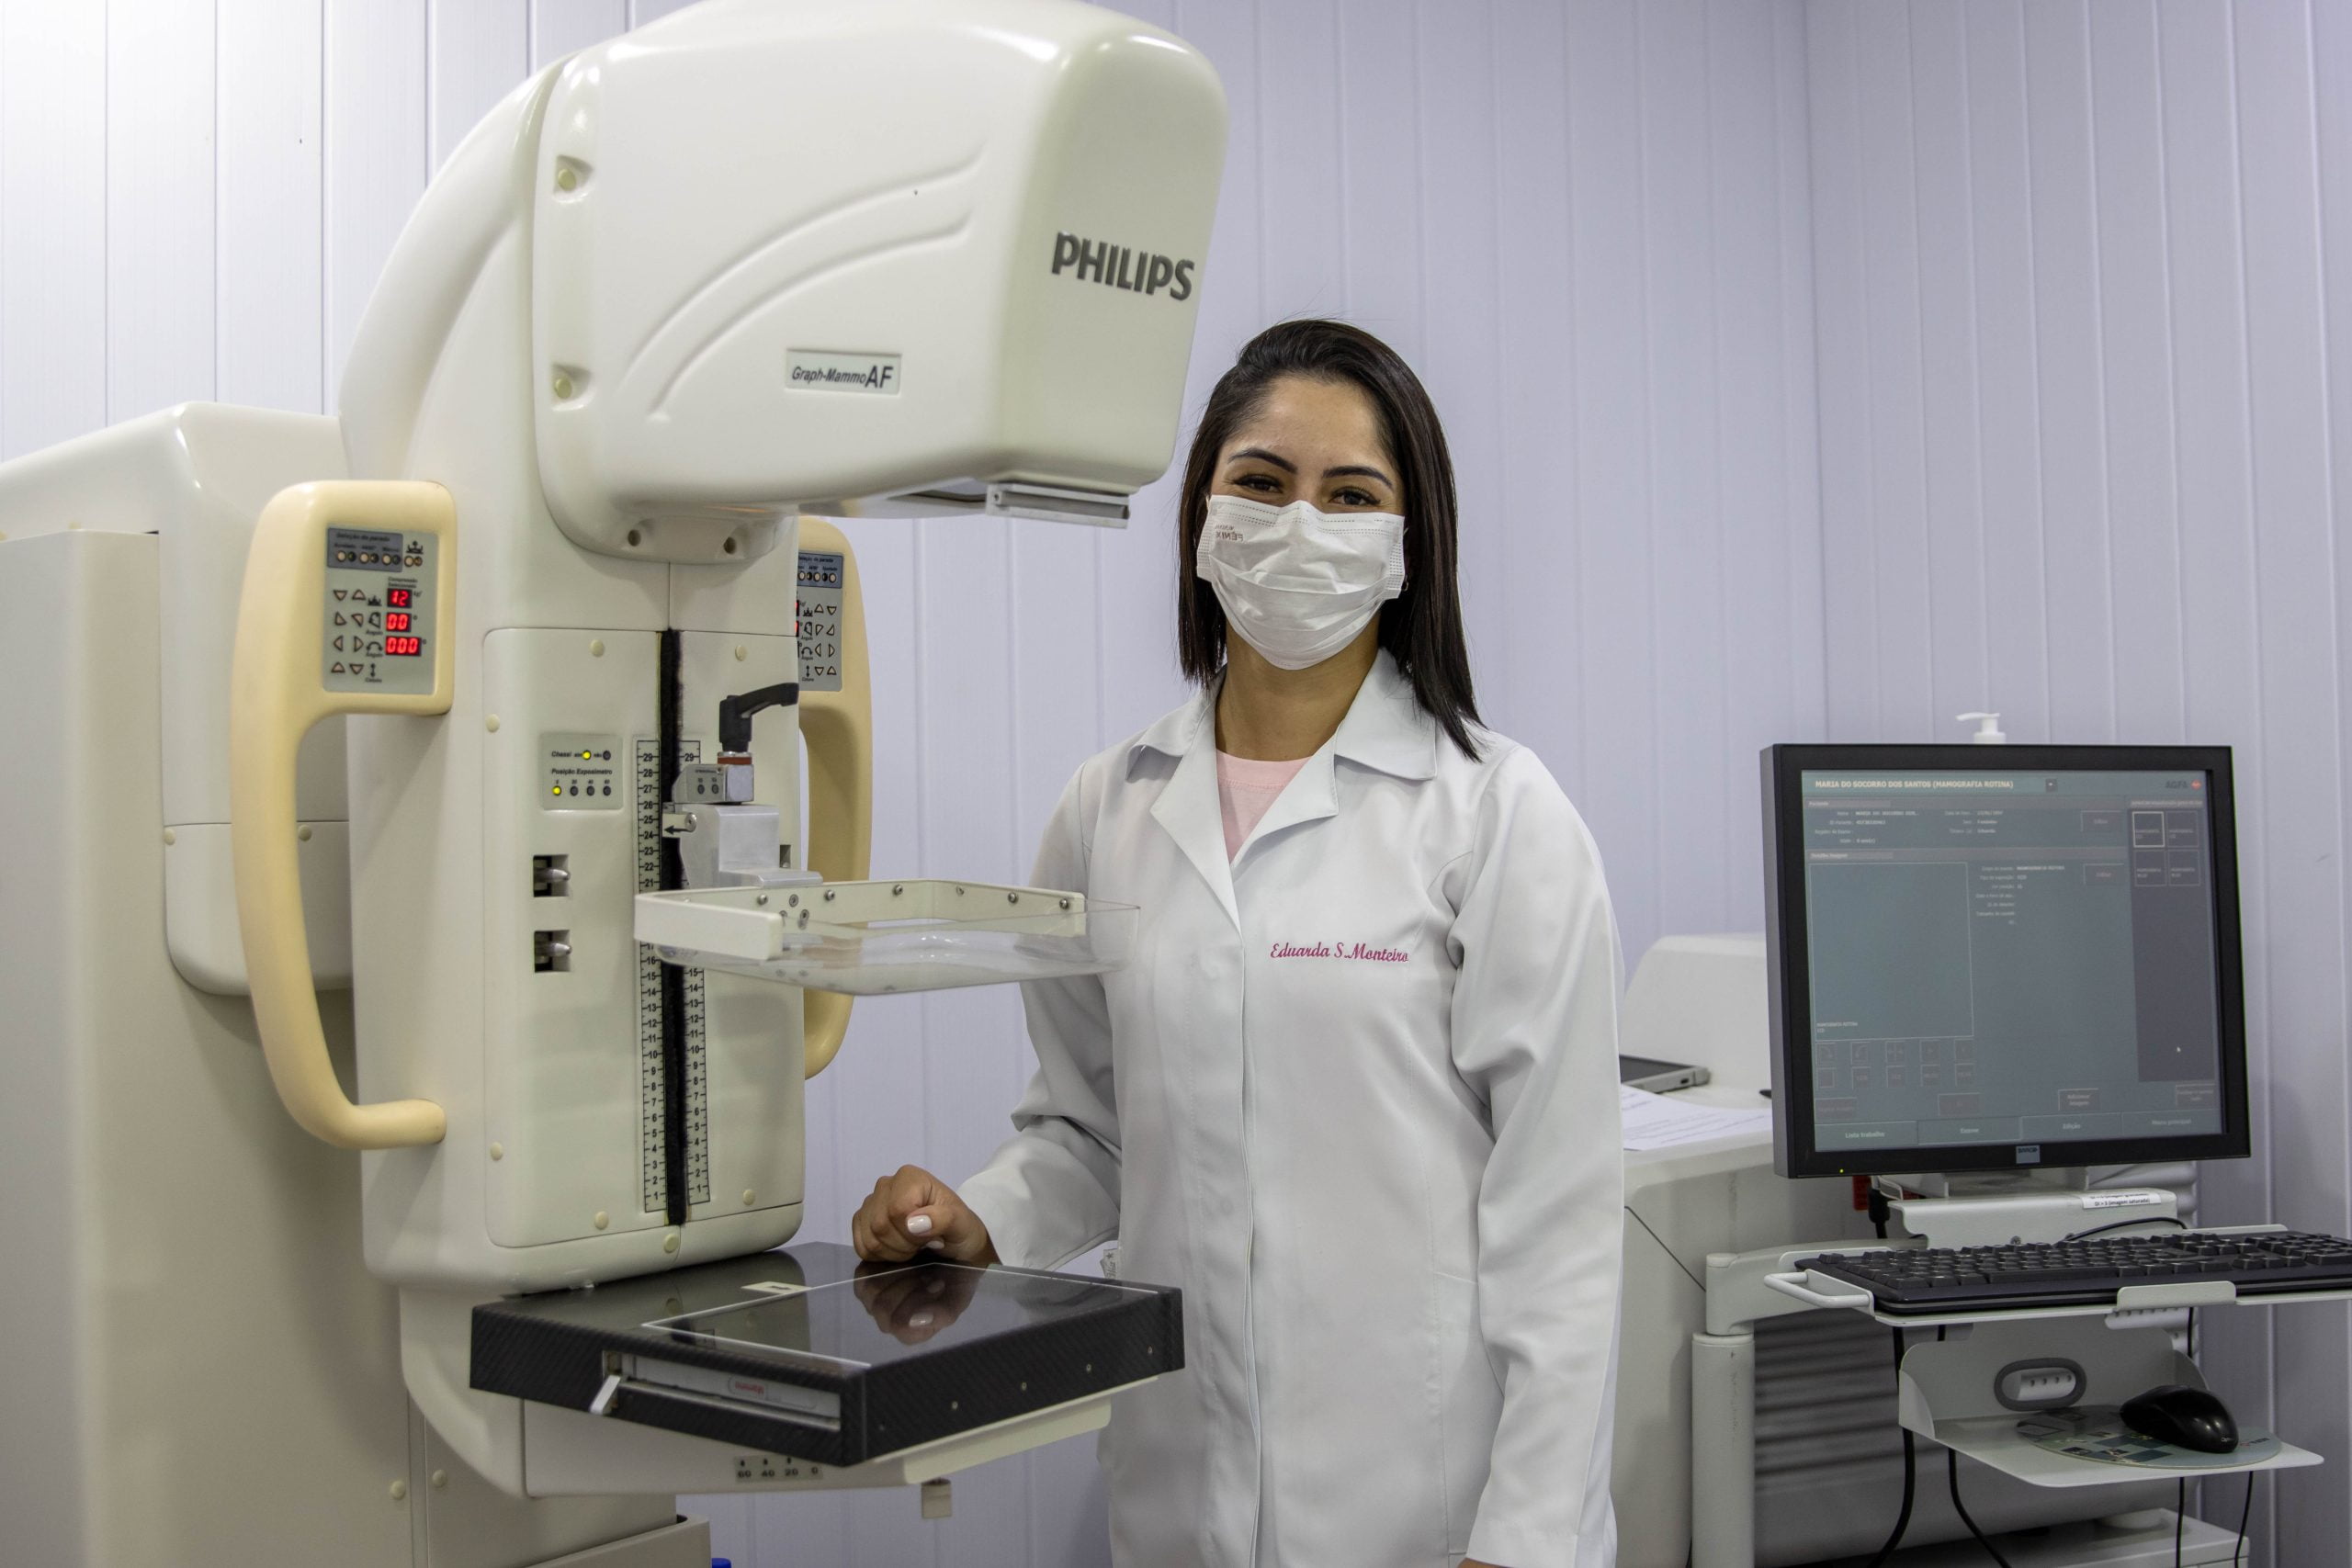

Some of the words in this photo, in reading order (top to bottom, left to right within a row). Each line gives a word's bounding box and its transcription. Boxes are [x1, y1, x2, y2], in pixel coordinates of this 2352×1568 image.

[1051, 231, 1195, 301] PHILIPS
[390, 590, 410, 607] 12
[388, 614, 408, 630] 00
[387, 637, 418, 654] 000
[643, 753, 653, 761] 29
[685, 753, 695, 761] 29
[643, 769, 653, 777] 28
[643, 784, 653, 793] 27
[1815, 780, 1840, 788] MARIA
[1984, 780, 2013, 789] ROTINA)
[643, 800, 653, 809] 26
[643, 816, 653, 824] 25
[644, 831, 653, 840] 24
[644, 847, 654, 855] 23
[645, 863, 654, 871] 22
[645, 878, 654, 887] 21
[1270, 942, 1330, 958] Eduarda
[647, 956, 656, 964] 16
[647, 972, 656, 981] 15
[689, 968, 698, 976] 15
[648, 988, 656, 997] 14
[649, 1004, 657, 1012] 13
[689, 999, 698, 1008] 13
[690, 1015, 699, 1023] 12
[649, 1020, 657, 1028] 12
[649, 1034, 657, 1043] 11
[691, 1045, 700, 1055] 10
[649, 1051, 658, 1059] 10
[737, 1470, 752, 1478] 60
[785, 1468, 798, 1477] 20
